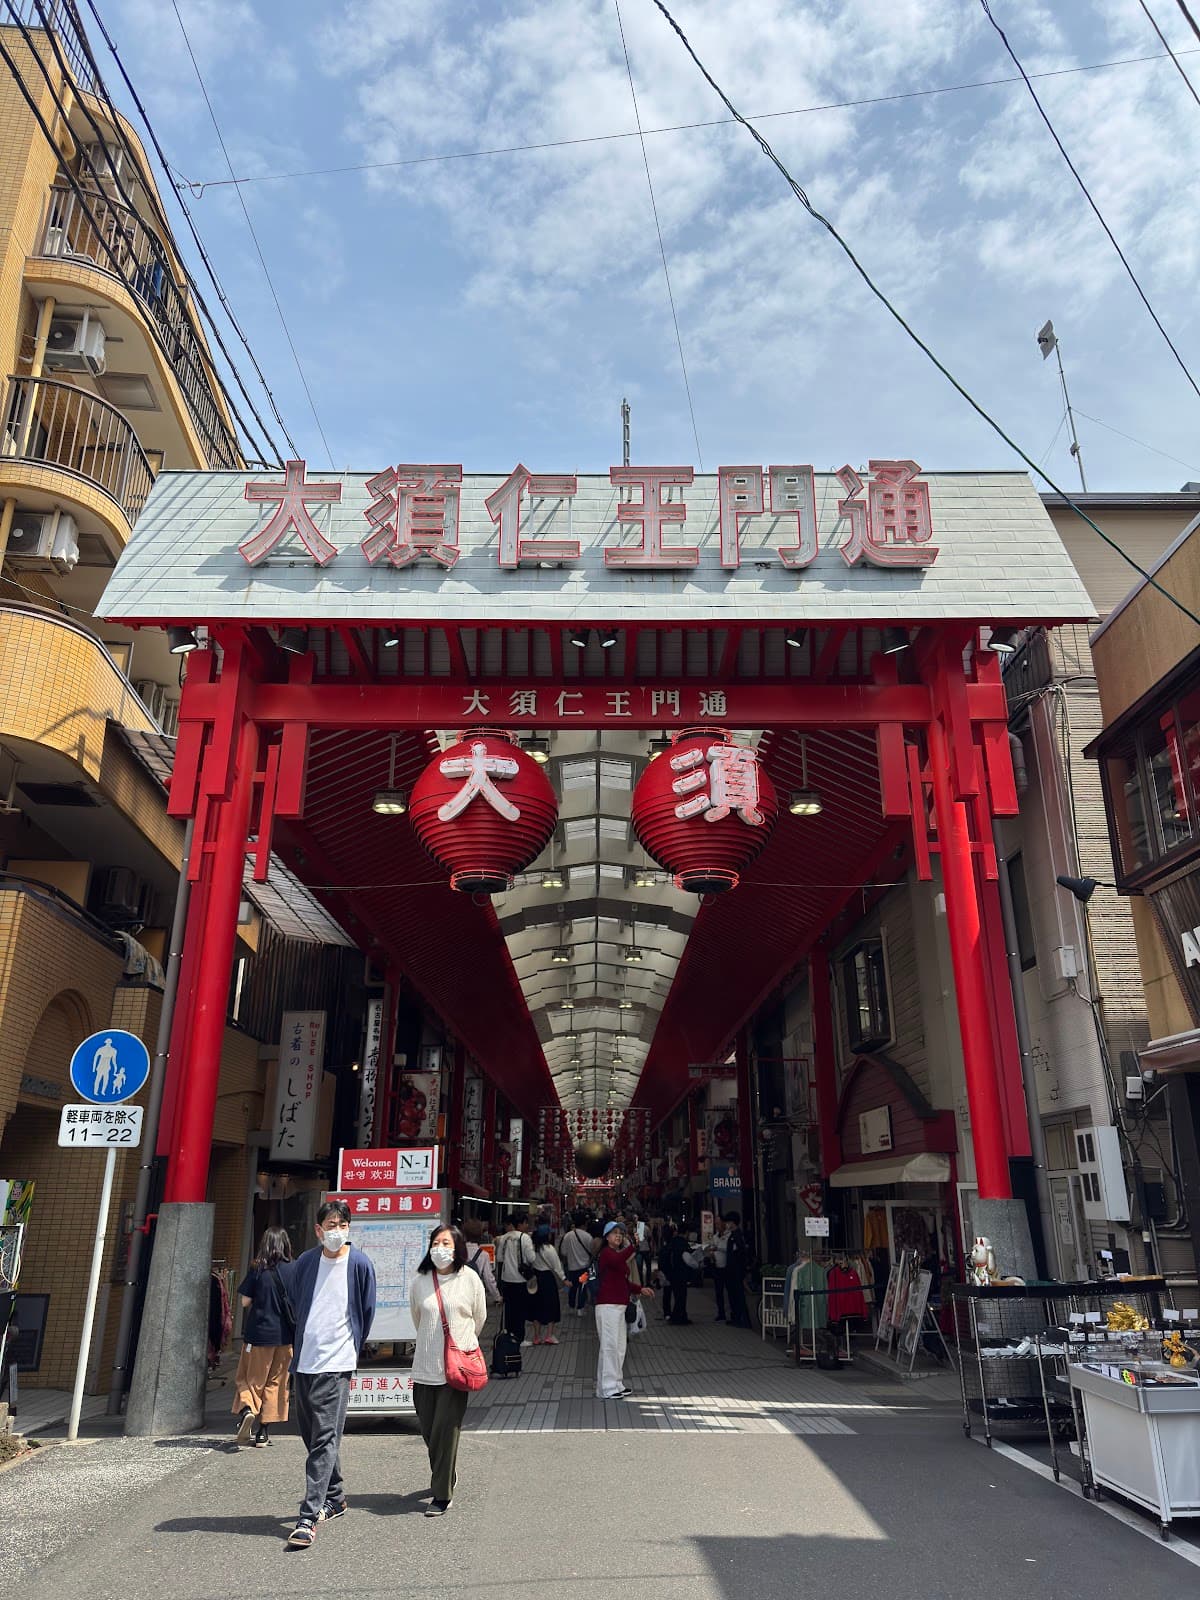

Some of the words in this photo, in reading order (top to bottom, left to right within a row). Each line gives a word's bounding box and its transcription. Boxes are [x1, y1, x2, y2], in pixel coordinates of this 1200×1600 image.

[238, 459, 940, 570] 大須仁王門通
[462, 688, 729, 718] 大須仁王門通
[305, 1064, 315, 1099] SHOP
[66, 1110, 138, 1125] 軽車両を除く
[68, 1127, 132, 1142] 11-22
[352, 1158, 392, 1168] Welcome
[400, 1154, 430, 1169] N-1
[371, 1169, 395, 1180] 欢迎
[713, 1176, 742, 1189] BRAND
[336, 1196, 433, 1211] 王門通り
